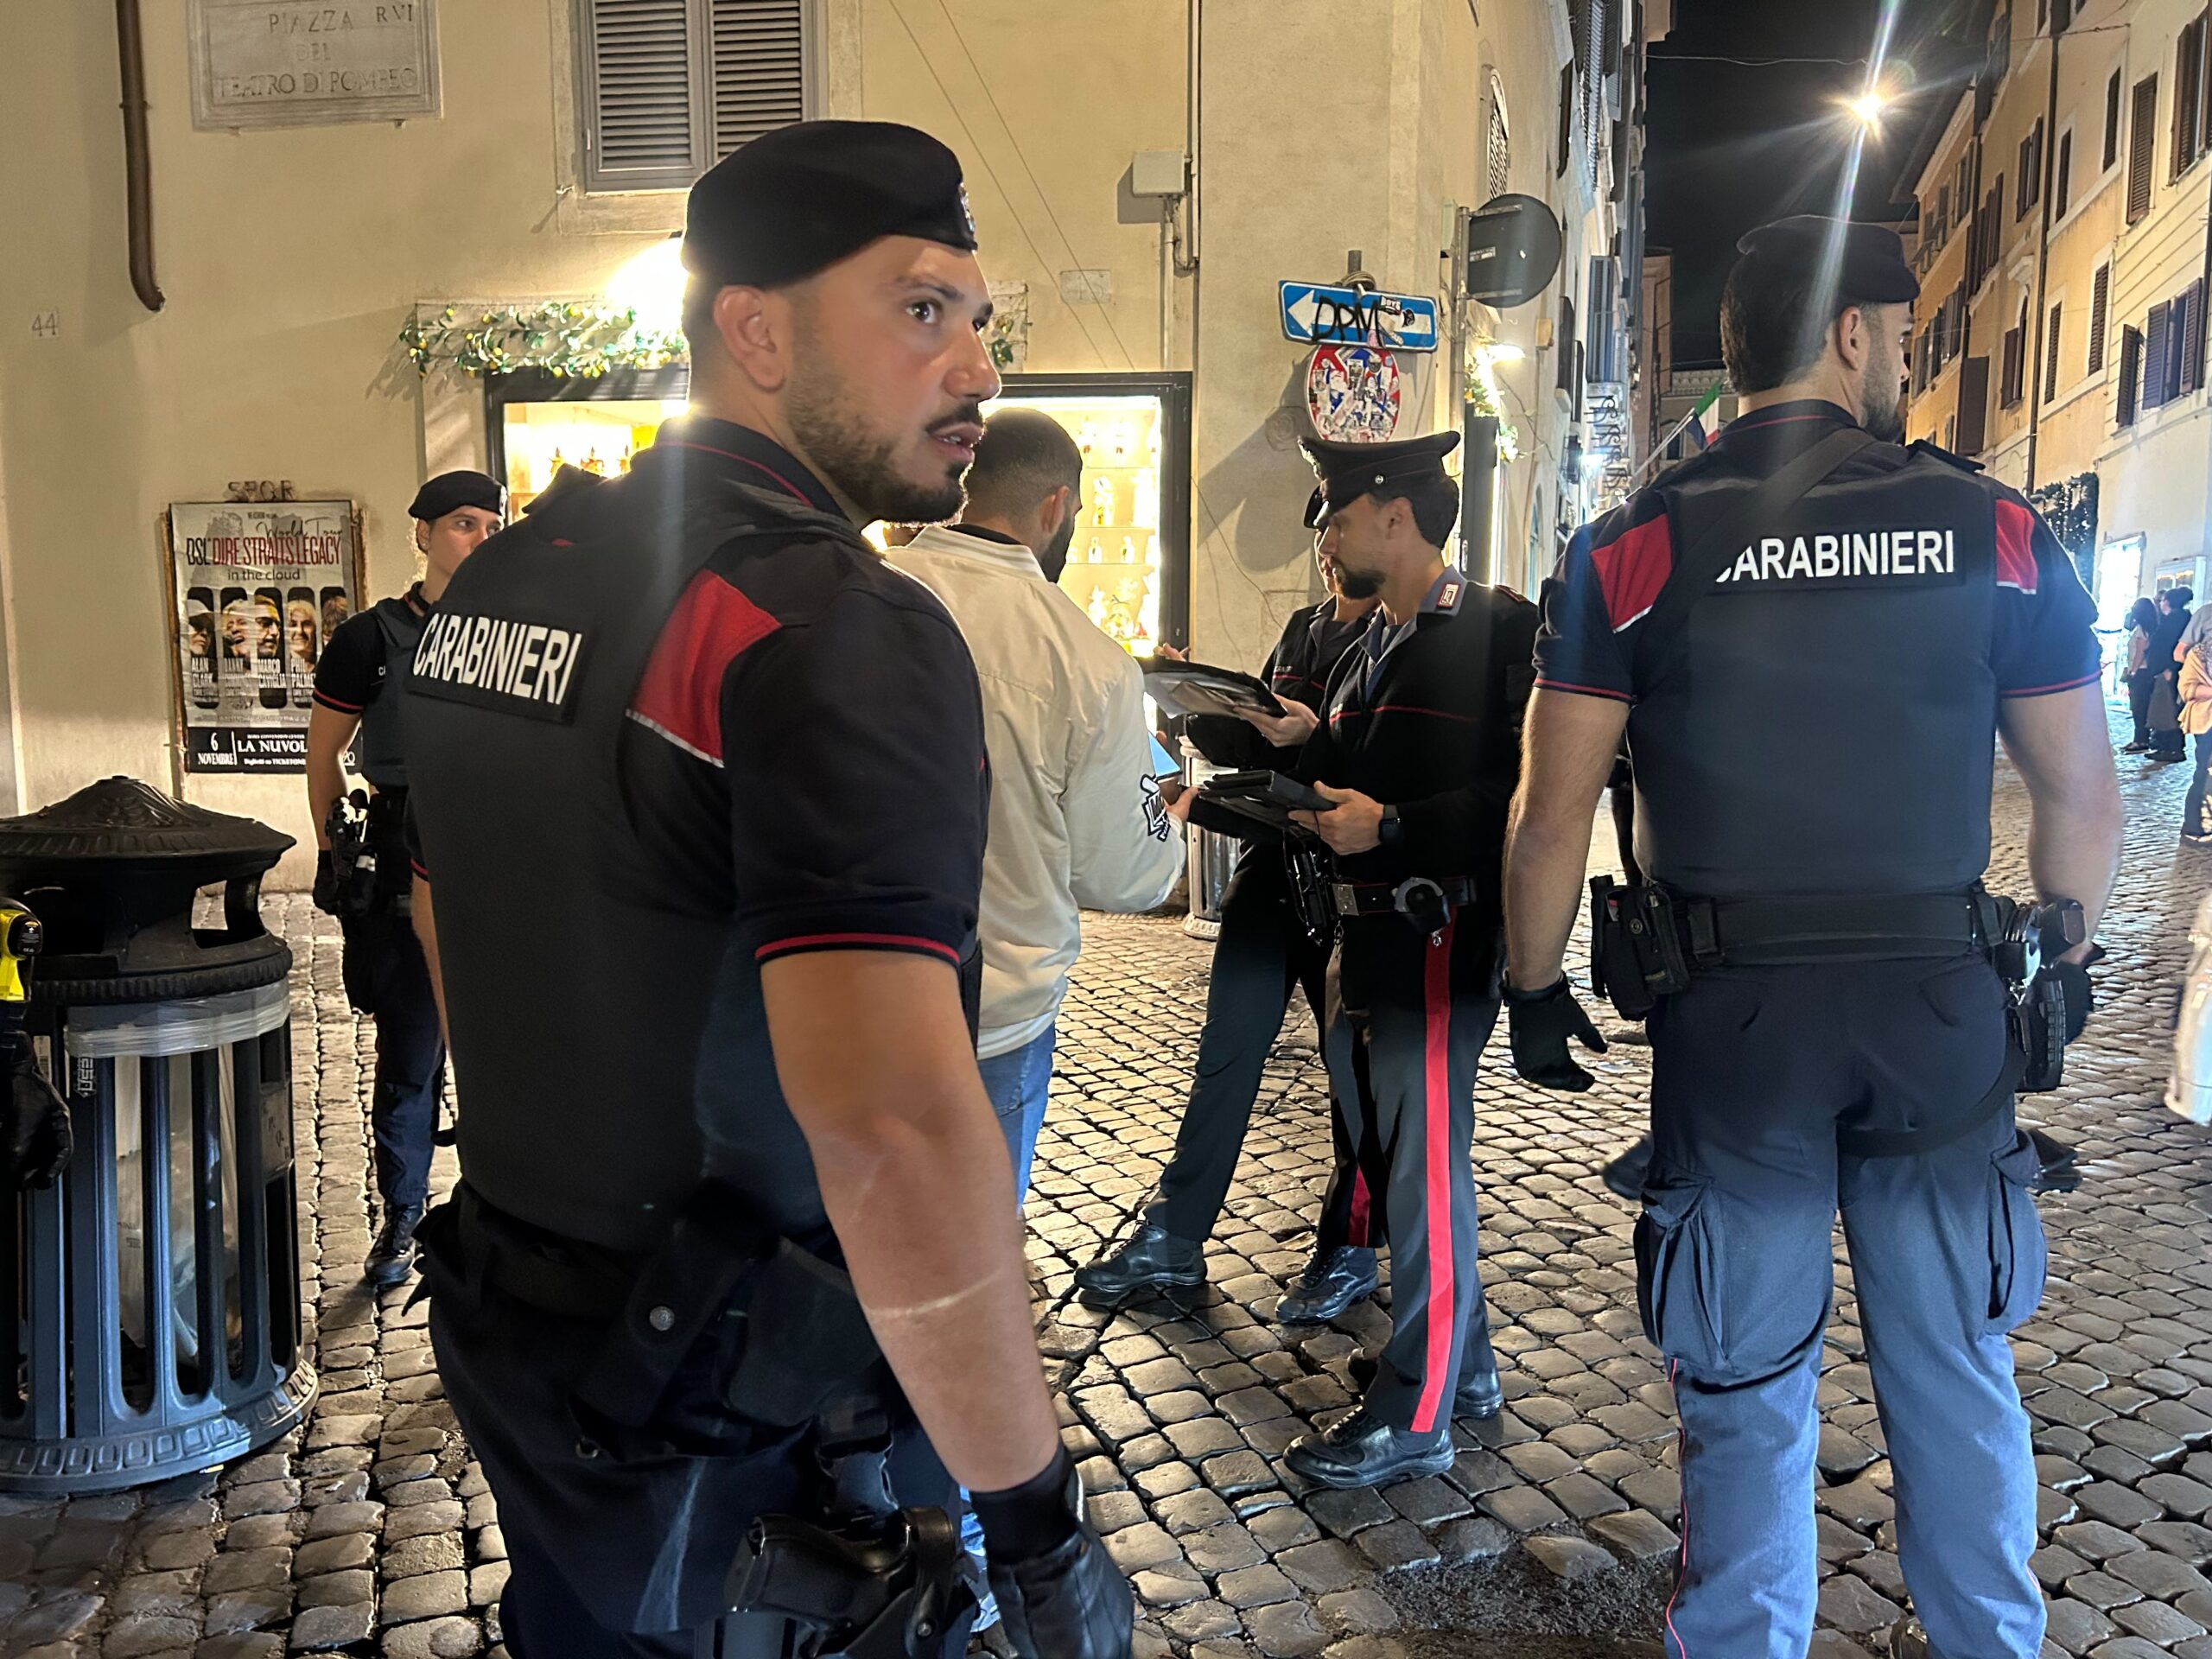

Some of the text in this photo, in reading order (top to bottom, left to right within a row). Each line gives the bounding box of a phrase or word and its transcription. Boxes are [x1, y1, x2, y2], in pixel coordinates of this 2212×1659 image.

[269, 10, 353, 34] PIAZZA
[31, 313, 56, 337] 44
[256, 519, 308, 538] World
[213, 537, 240, 565] DIRE
[243, 537, 295, 565] STRAITS
[296, 536, 341, 565] LEGACY
[1715, 530, 1955, 583] ARABINIERI
[228, 568, 301, 581] in the cloud
[412, 612, 583, 706] CARABINIERI
[210, 732, 219, 752] 6
[237, 740, 308, 753] LA NUVOL
[197, 753, 234, 766] NOVEMBRE
